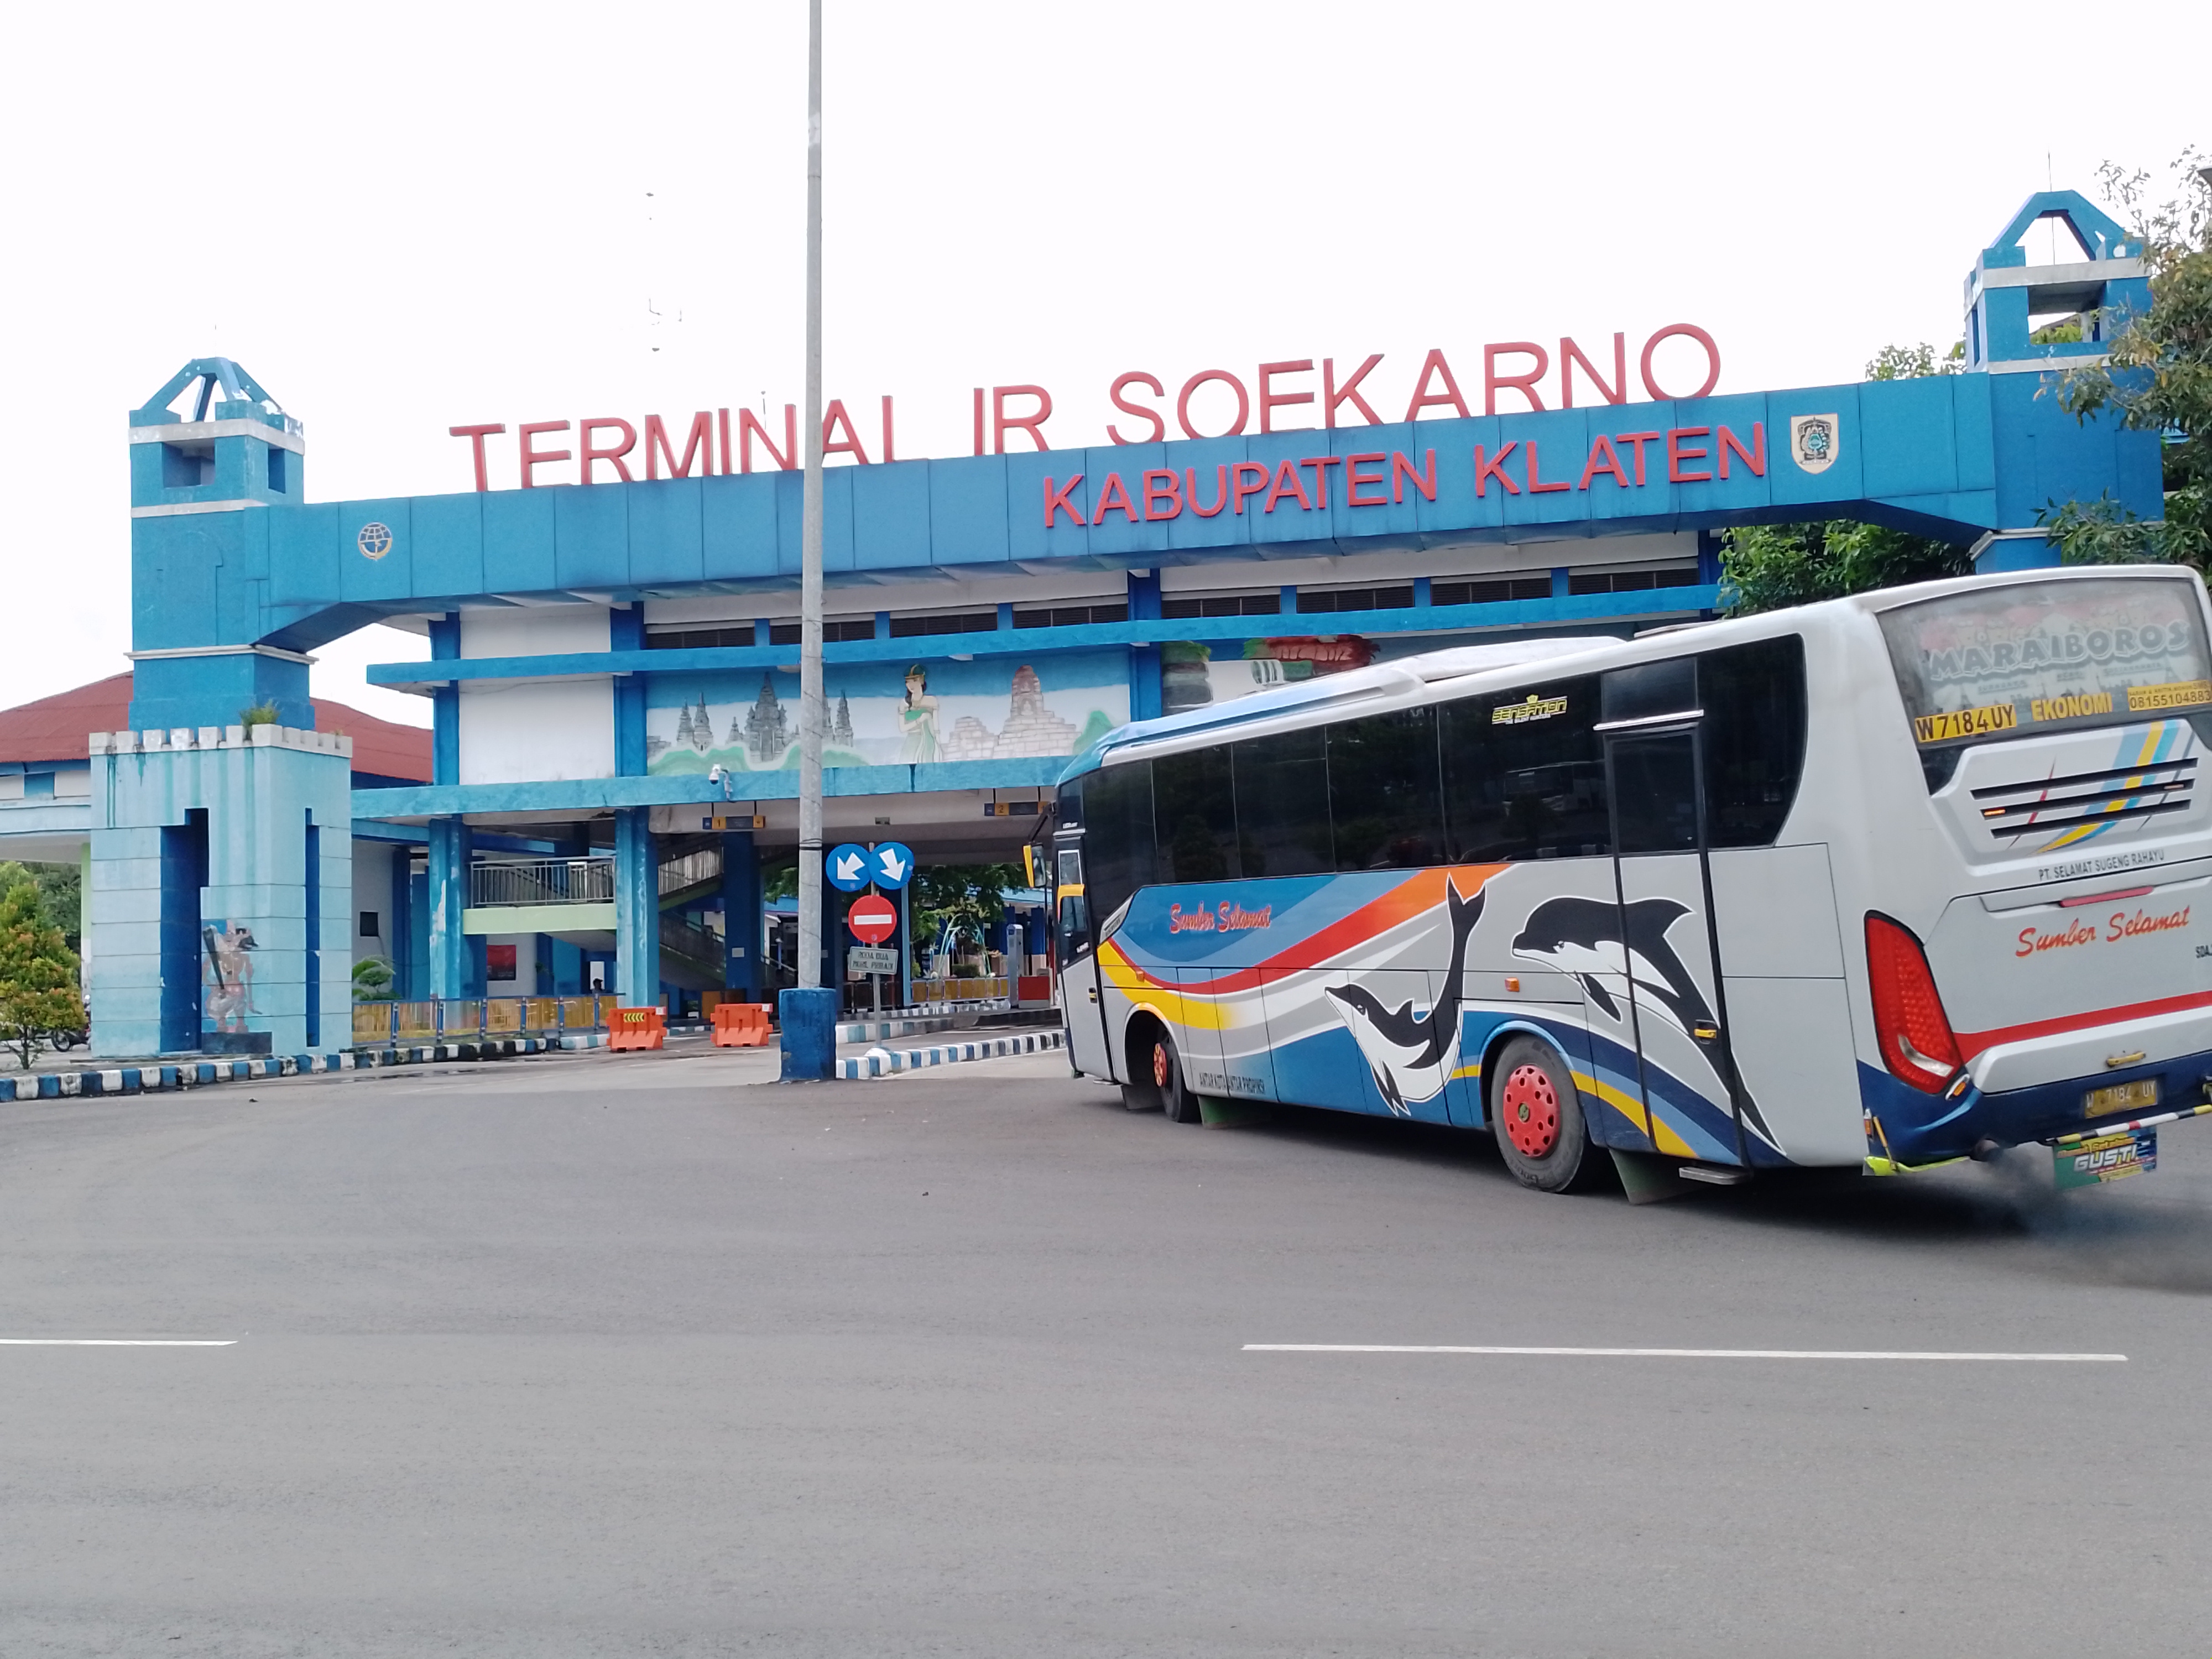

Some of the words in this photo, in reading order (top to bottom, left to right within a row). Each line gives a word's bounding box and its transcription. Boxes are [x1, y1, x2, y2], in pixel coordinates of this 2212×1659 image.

[449, 394, 930, 493] TERMINAL
[973, 384, 1052, 457] IR
[1105, 323, 1721, 446] SOEKARNO
[1043, 447, 1437, 528] KABUPATEN
[1474, 421, 1767, 498] KLATEN
[1916, 717, 1934, 741] W
[1937, 710, 1989, 738] 7184
[1990, 704, 2013, 728] UY
[2031, 692, 2113, 721] EKONOMI
[2054, 860, 2093, 879] SELAMAT
[2095, 855, 2130, 872] SUGENG
[2131, 849, 2165, 865] RAHAYU
[1170, 900, 1215, 935] Sumber
[1218, 900, 1272, 933] Selamat
[2015, 917, 2097, 957] Sumber
[2106, 905, 2190, 942] Selamat
[2086, 1092, 2094, 1109] W
[2105, 1087, 2131, 1102] 7184
[2142, 1079, 2156, 1098] UY
[2074, 1143, 2138, 1172] GUSTI
